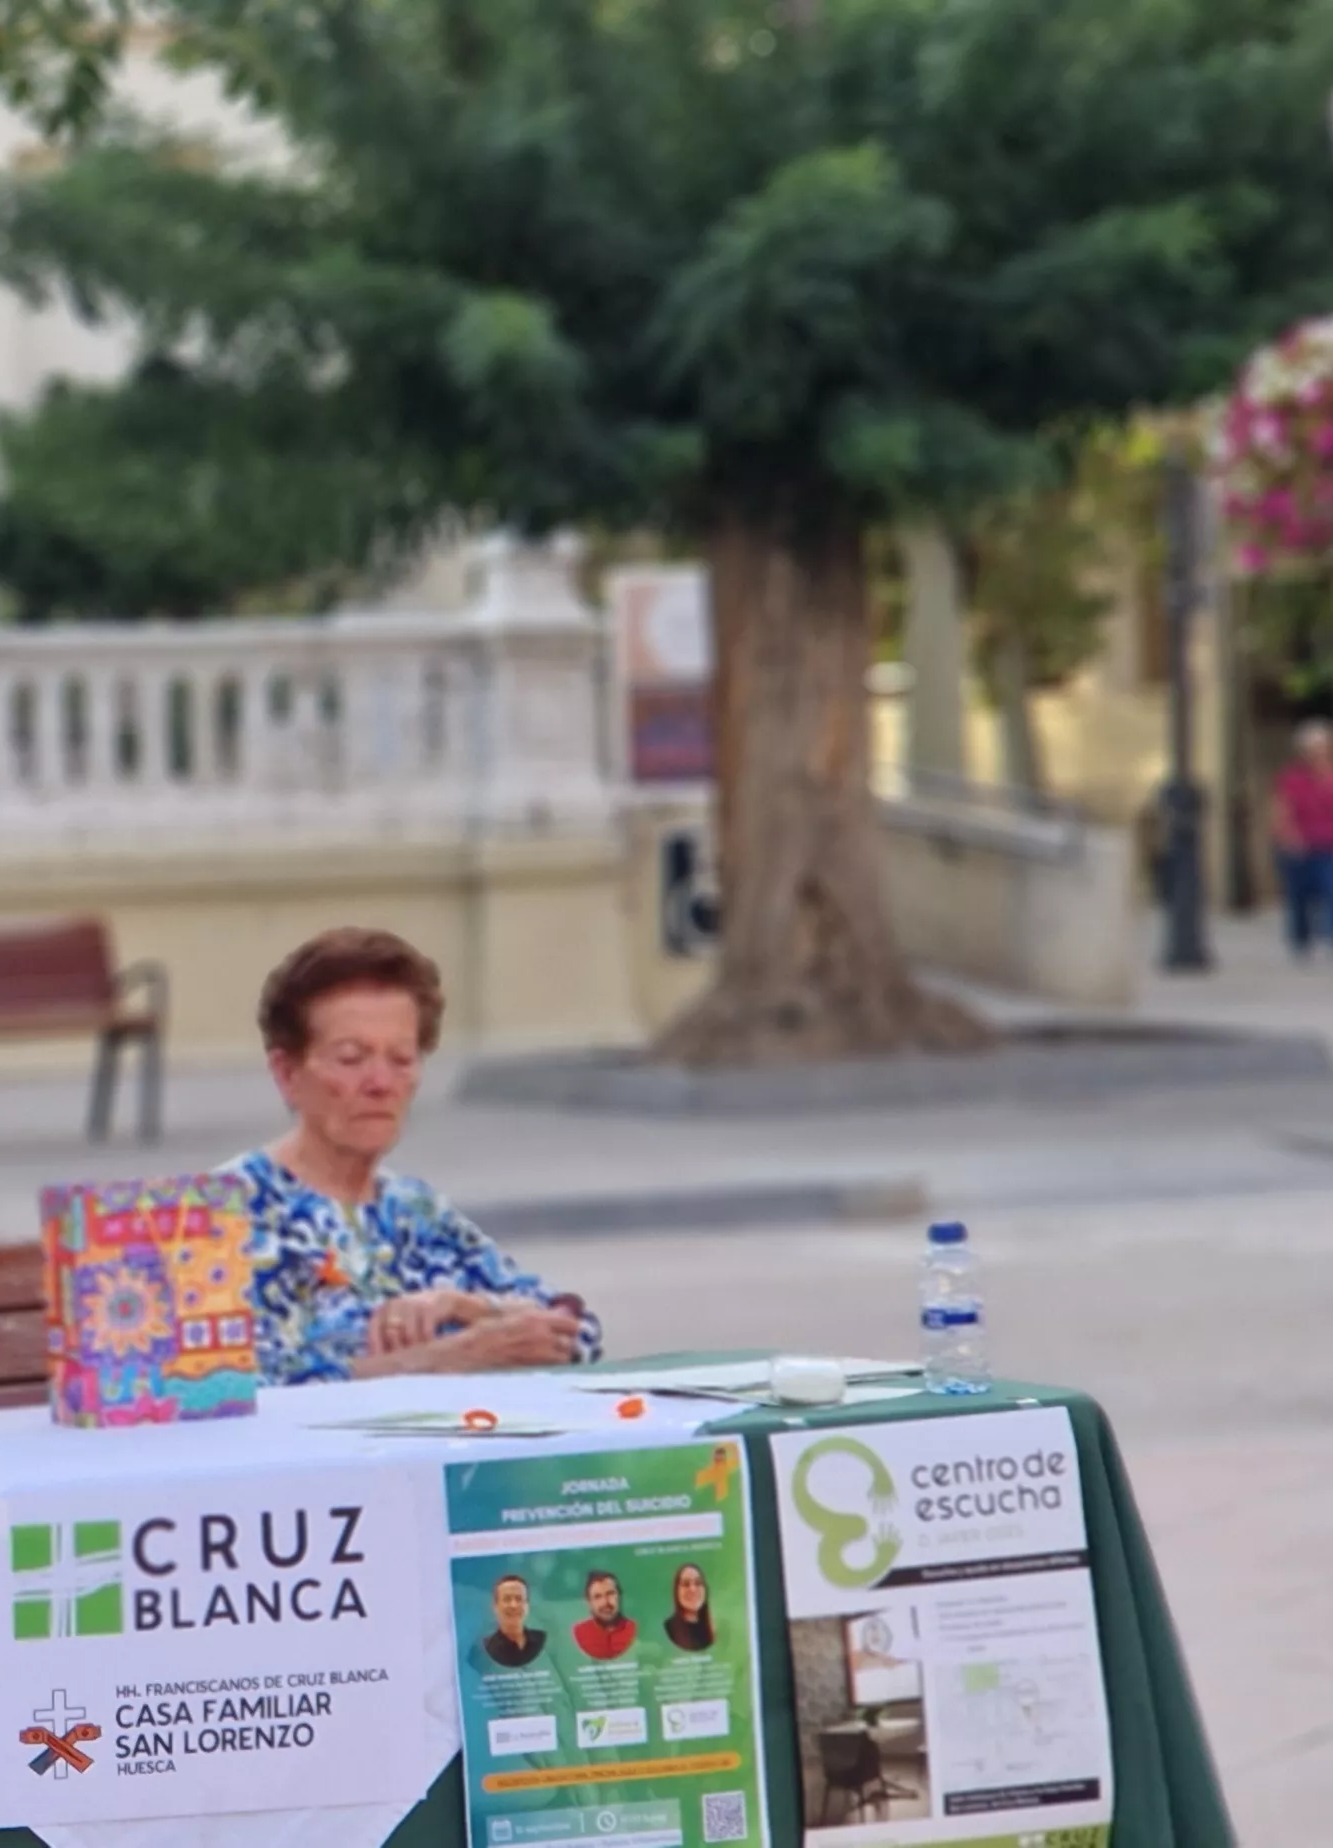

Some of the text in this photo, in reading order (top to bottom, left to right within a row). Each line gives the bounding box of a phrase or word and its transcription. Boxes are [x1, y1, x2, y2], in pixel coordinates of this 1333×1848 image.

[560, 1476, 630, 1496] JORNADA
[910, 1449, 1066, 1490] centro de
[500, 1501, 593, 1523] PREVENCIÓN
[597, 1501, 622, 1515] DEL
[914, 1484, 1062, 1523] escucha
[131, 1506, 365, 1577] CRUZ
[133, 1577, 368, 1632] BLANCA
[115, 1668, 389, 1699] HH. FRANCISCANOS DE CRUZ BLANCA
[115, 1691, 333, 1730] CASA FAMILIAR
[115, 1721, 315, 1760] SAN LORENZO
[116, 1759, 177, 1776] HUESCA
